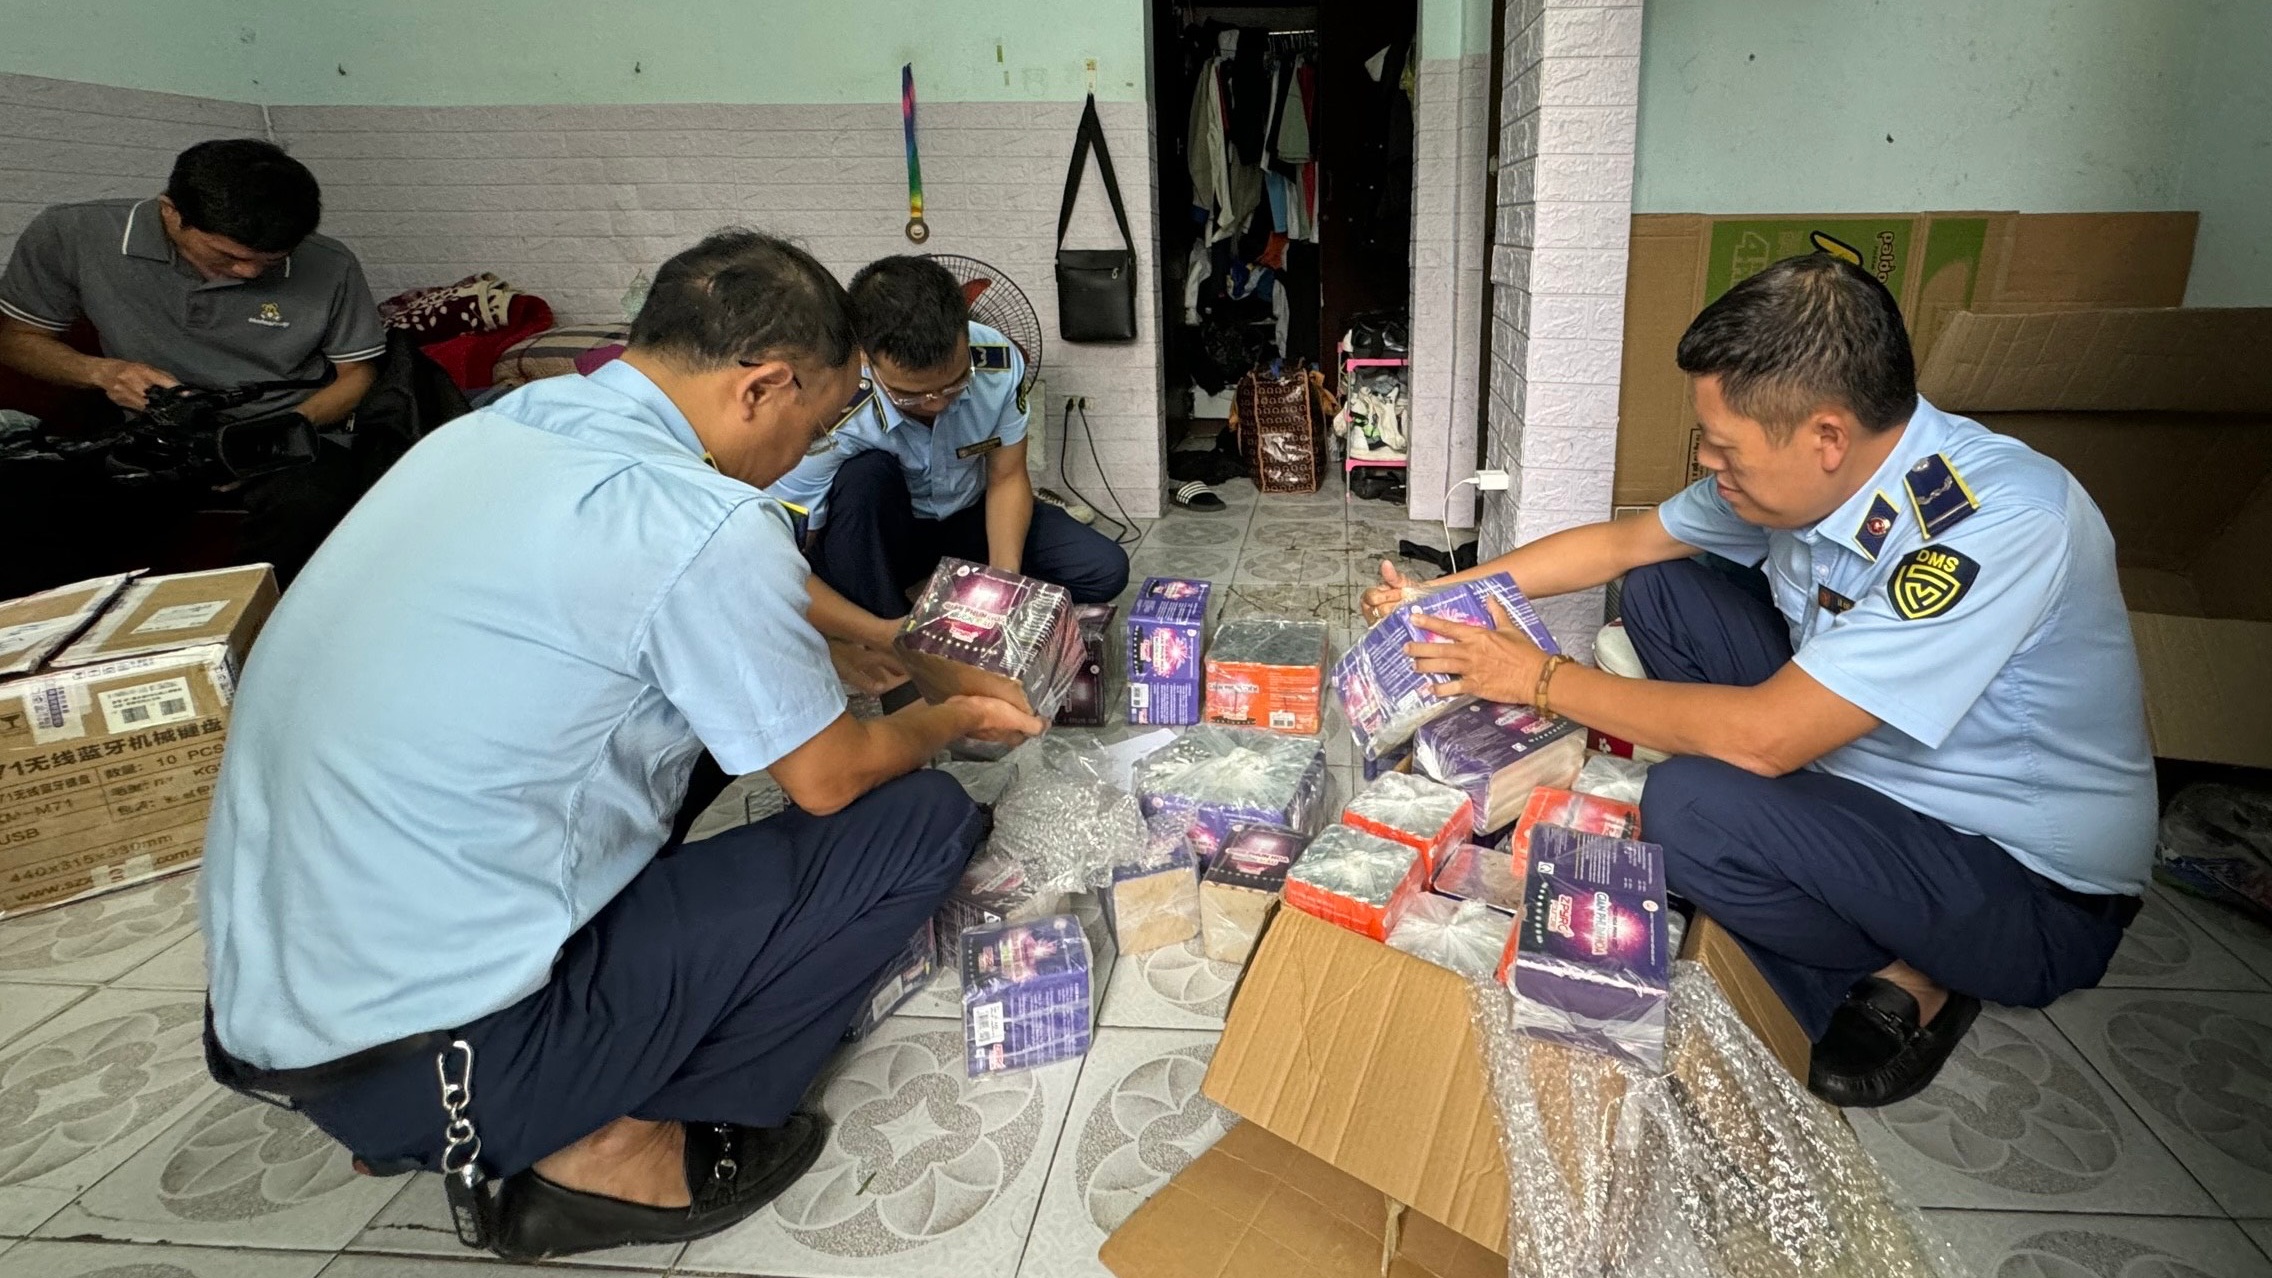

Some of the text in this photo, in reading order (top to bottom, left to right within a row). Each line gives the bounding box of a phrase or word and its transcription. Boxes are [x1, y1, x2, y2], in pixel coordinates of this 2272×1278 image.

[1876, 231, 1897, 284] paldo
[1916, 549, 1960, 573] DMS
[156, 755, 178, 768] 10
[187, 743, 225, 761] PCS
